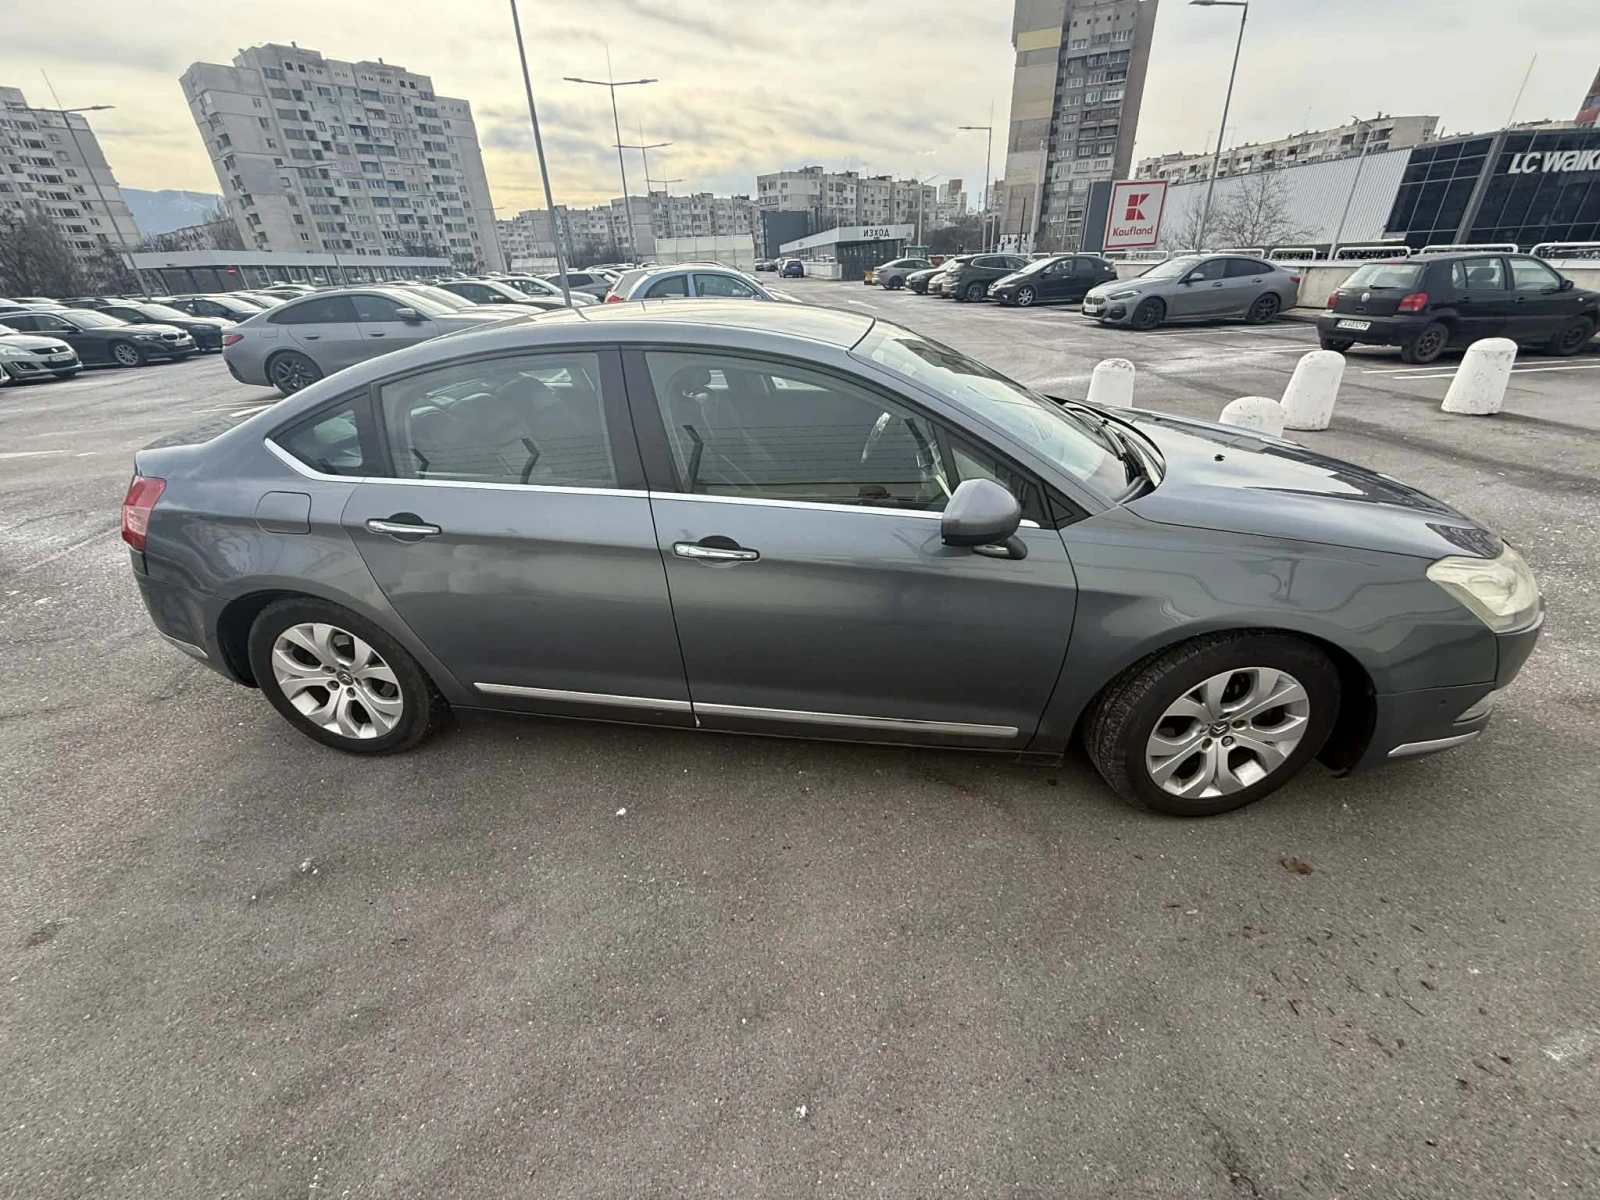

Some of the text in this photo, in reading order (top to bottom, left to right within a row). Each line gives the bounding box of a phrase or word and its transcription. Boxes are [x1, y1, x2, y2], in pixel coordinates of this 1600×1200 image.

[1507, 152, 1542, 174] LC
[863, 228, 890, 237] ИЗХОД
[1112, 225, 1154, 237] Kaufland
